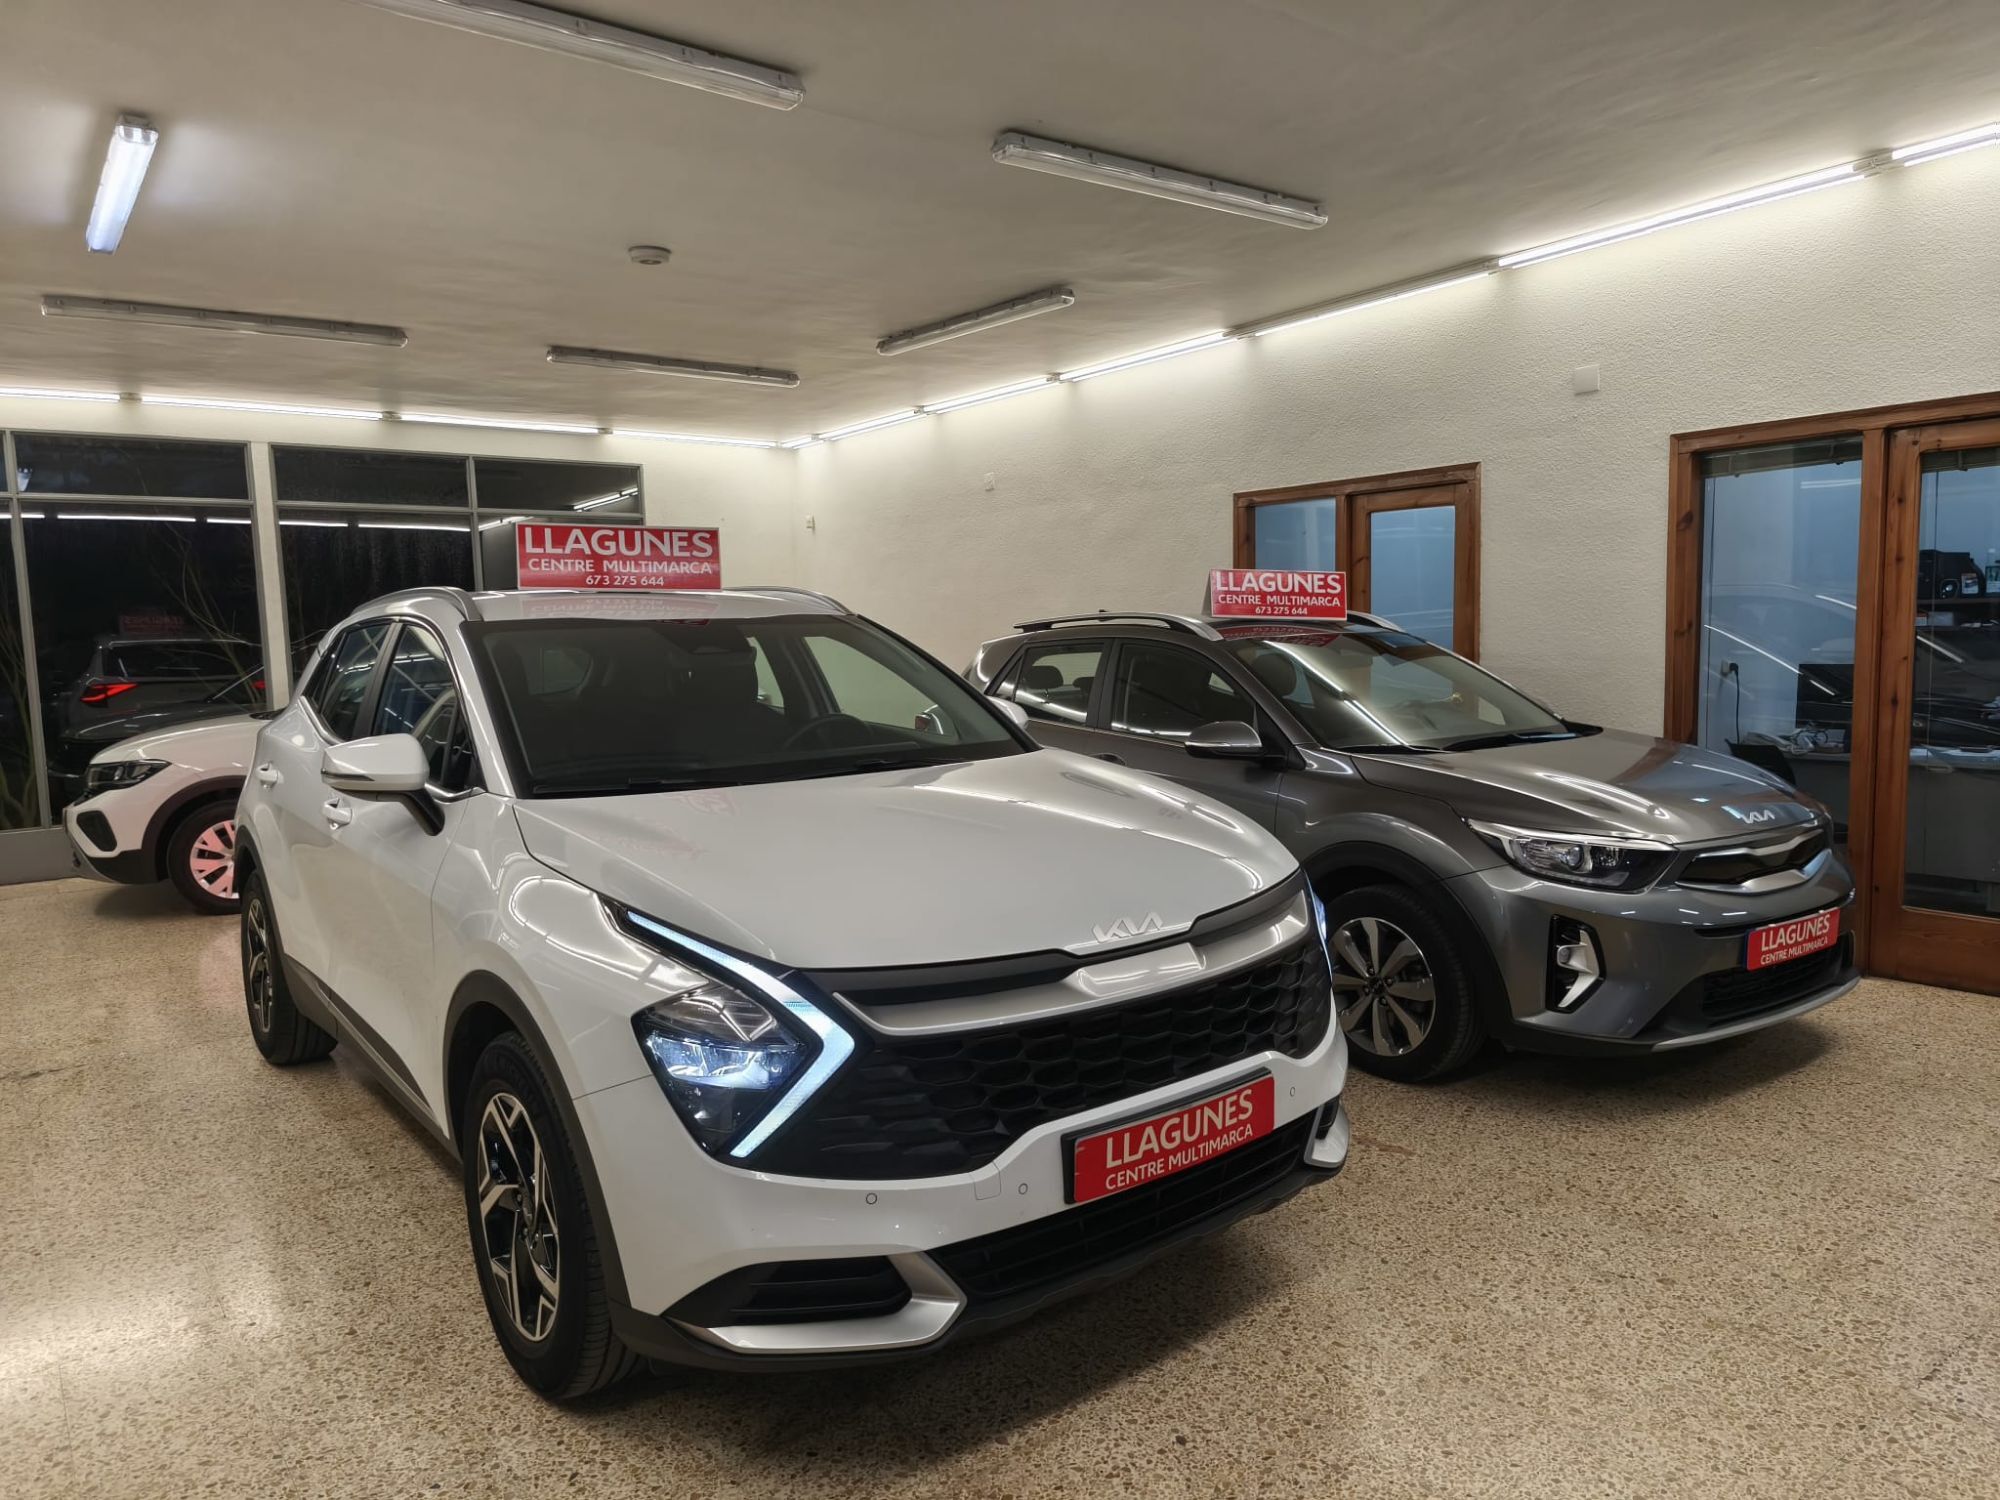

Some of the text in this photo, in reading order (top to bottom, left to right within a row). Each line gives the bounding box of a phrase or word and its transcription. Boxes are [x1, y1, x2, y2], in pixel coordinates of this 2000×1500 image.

[525, 527, 713, 557] LLAGUNES
[528, 558, 711, 574] CENTRE MULTIMARCA
[585, 575, 664, 587] 673 275 644
[1216, 571, 1341, 594] LLAGUNES
[1218, 594, 1341, 607] CENTRE MULTIMARCA
[1255, 606, 1308, 615] 673 275 644
[1761, 914, 1831, 952] LLAGUNES
[1760, 936, 1829, 965] CENTRE MULTIMARCA
[1106, 1088, 1254, 1169] LLAGUNES
[1105, 1123, 1253, 1190] CENTRE MULTIMARCA
